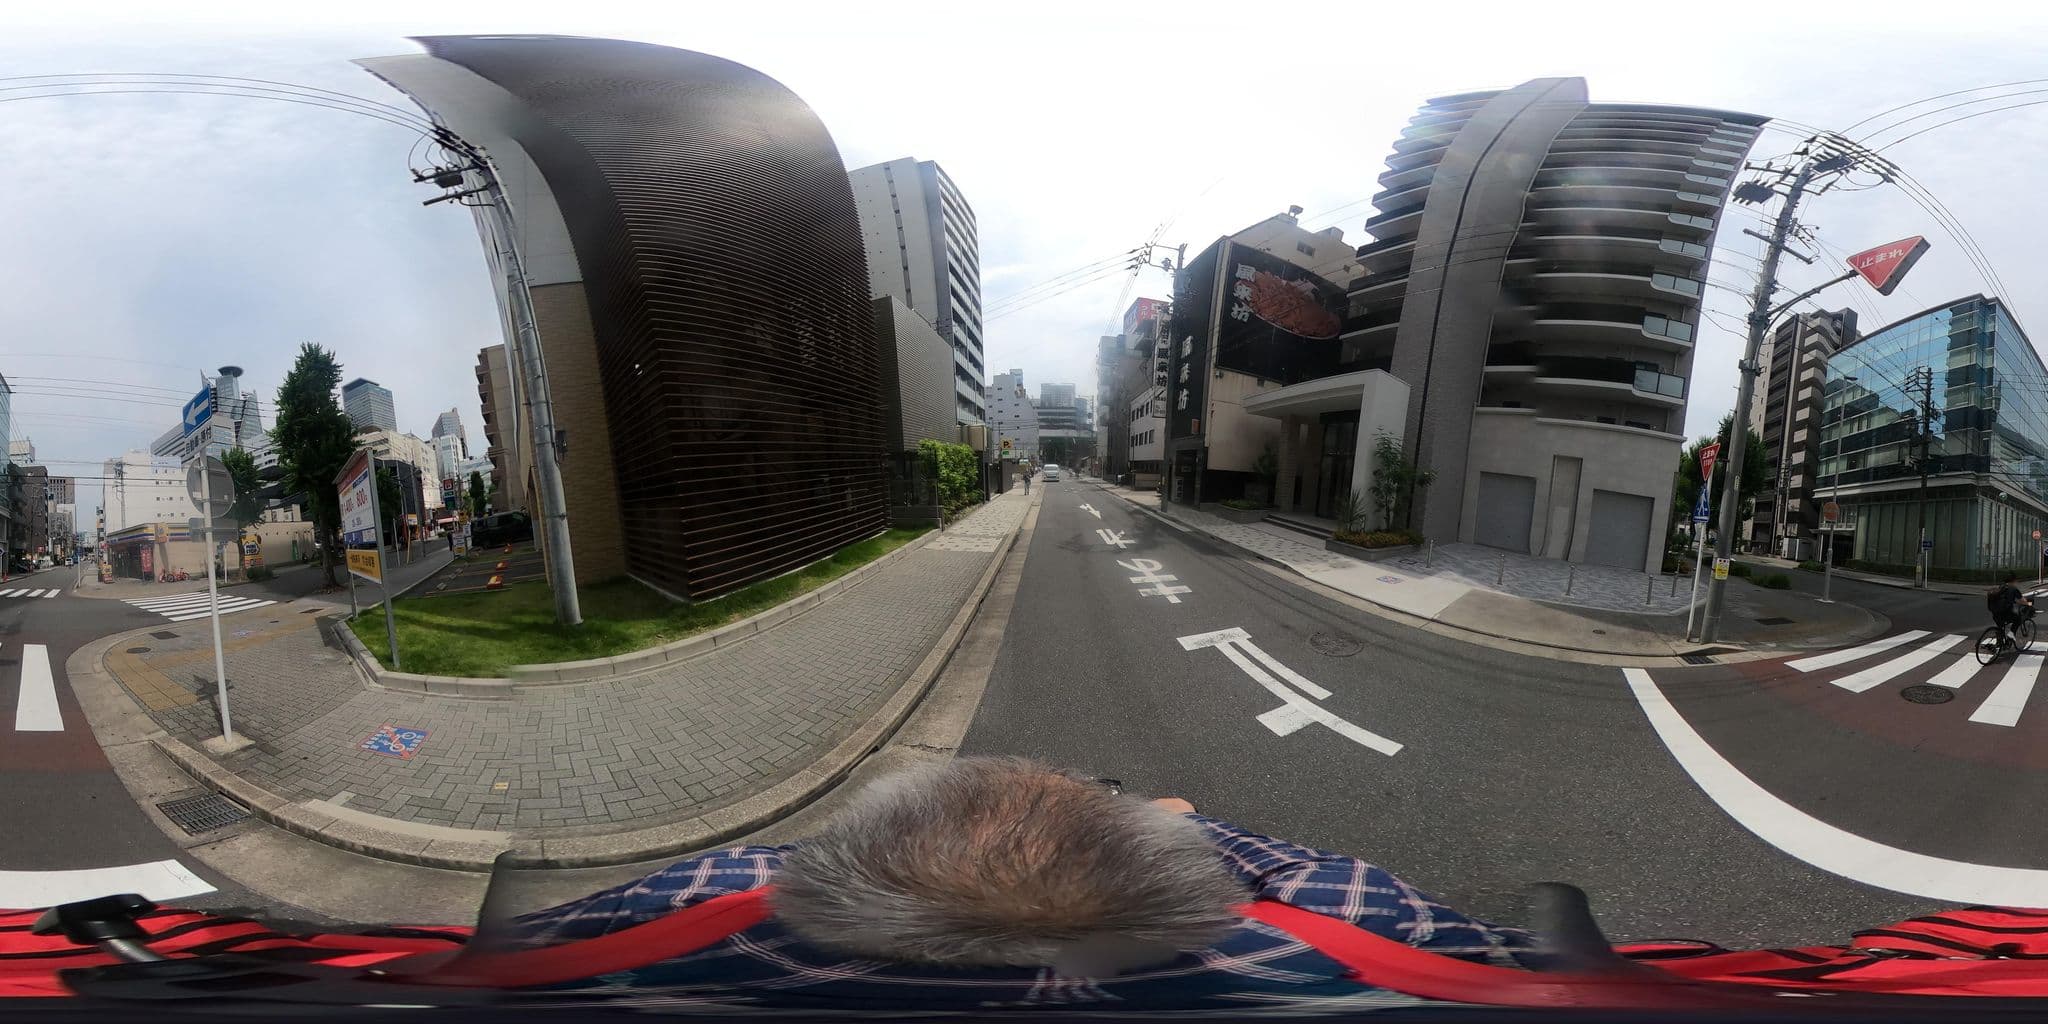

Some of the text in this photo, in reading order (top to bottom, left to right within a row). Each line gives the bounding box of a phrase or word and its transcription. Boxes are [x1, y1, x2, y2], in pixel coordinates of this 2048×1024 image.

[1860, 247, 1904, 269] 止まれ
[1702, 449, 1715, 460] 止まれ
